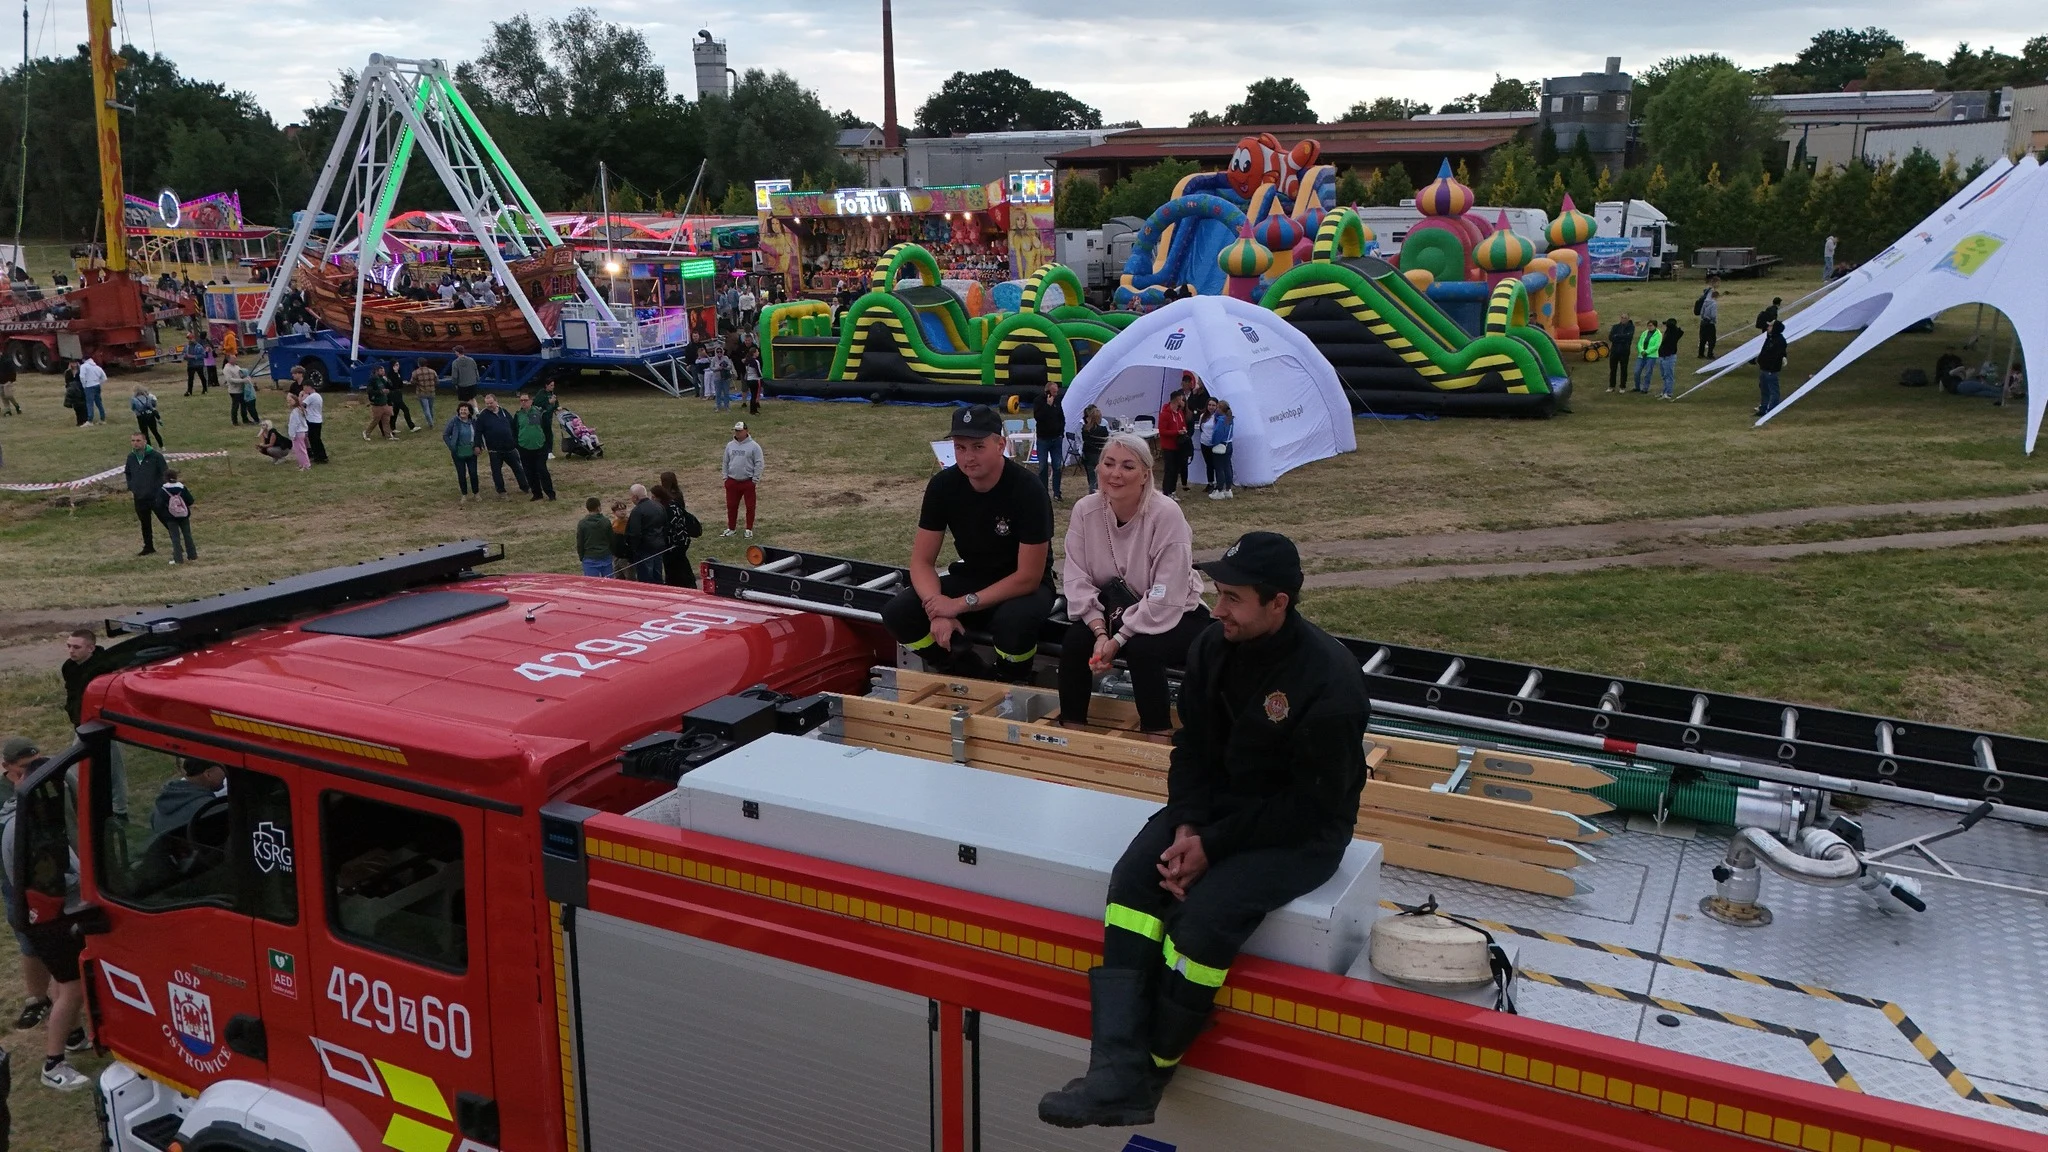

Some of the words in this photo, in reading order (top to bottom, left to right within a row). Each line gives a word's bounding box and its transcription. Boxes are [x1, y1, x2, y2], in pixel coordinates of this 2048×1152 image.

[833, 190, 913, 215] FORTUNA
[253, 839, 292, 866] KSRG
[174, 969, 201, 989] OSP
[274, 973, 293, 988] AED
[161, 1024, 232, 1074] OSTROWICE
